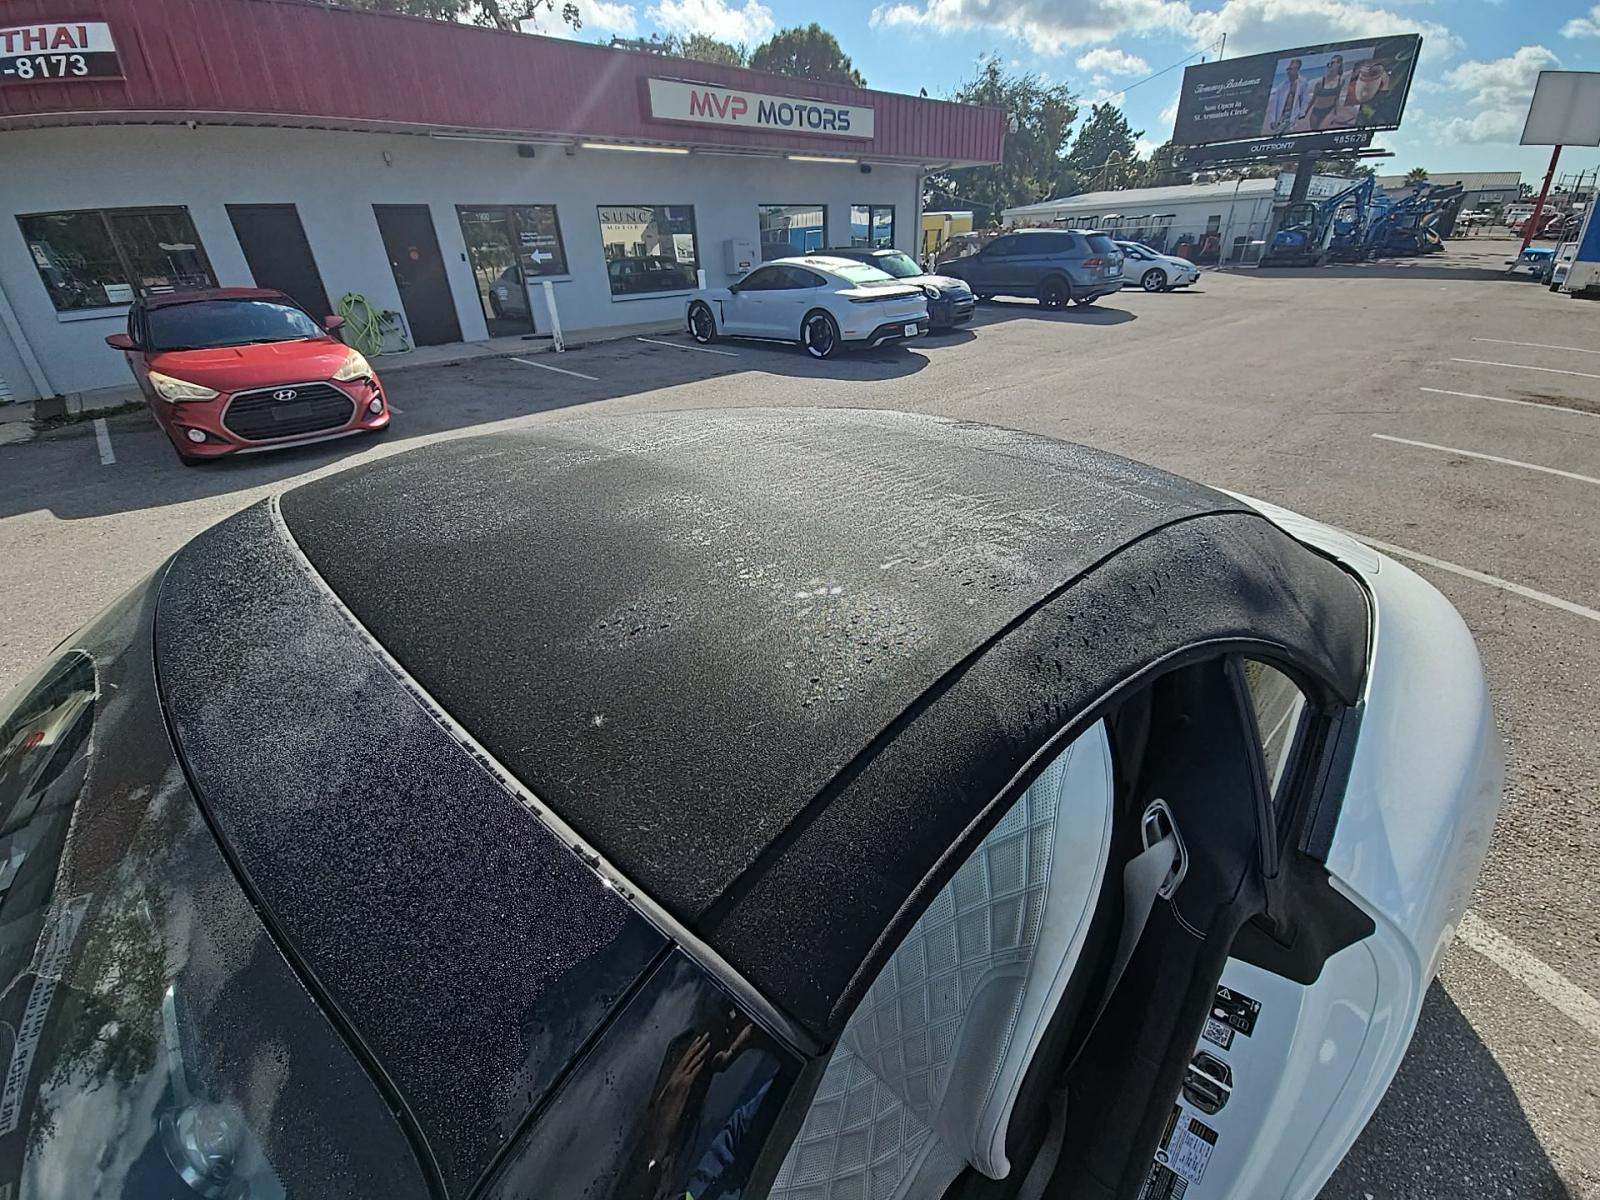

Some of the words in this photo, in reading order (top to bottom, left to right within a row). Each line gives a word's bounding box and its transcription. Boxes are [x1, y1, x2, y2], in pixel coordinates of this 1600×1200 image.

[0, 26, 88, 52] THAI
[4, 54, 88, 79] -8173
[690, 91, 748, 120] MVP
[757, 100, 850, 131] MOTORS
